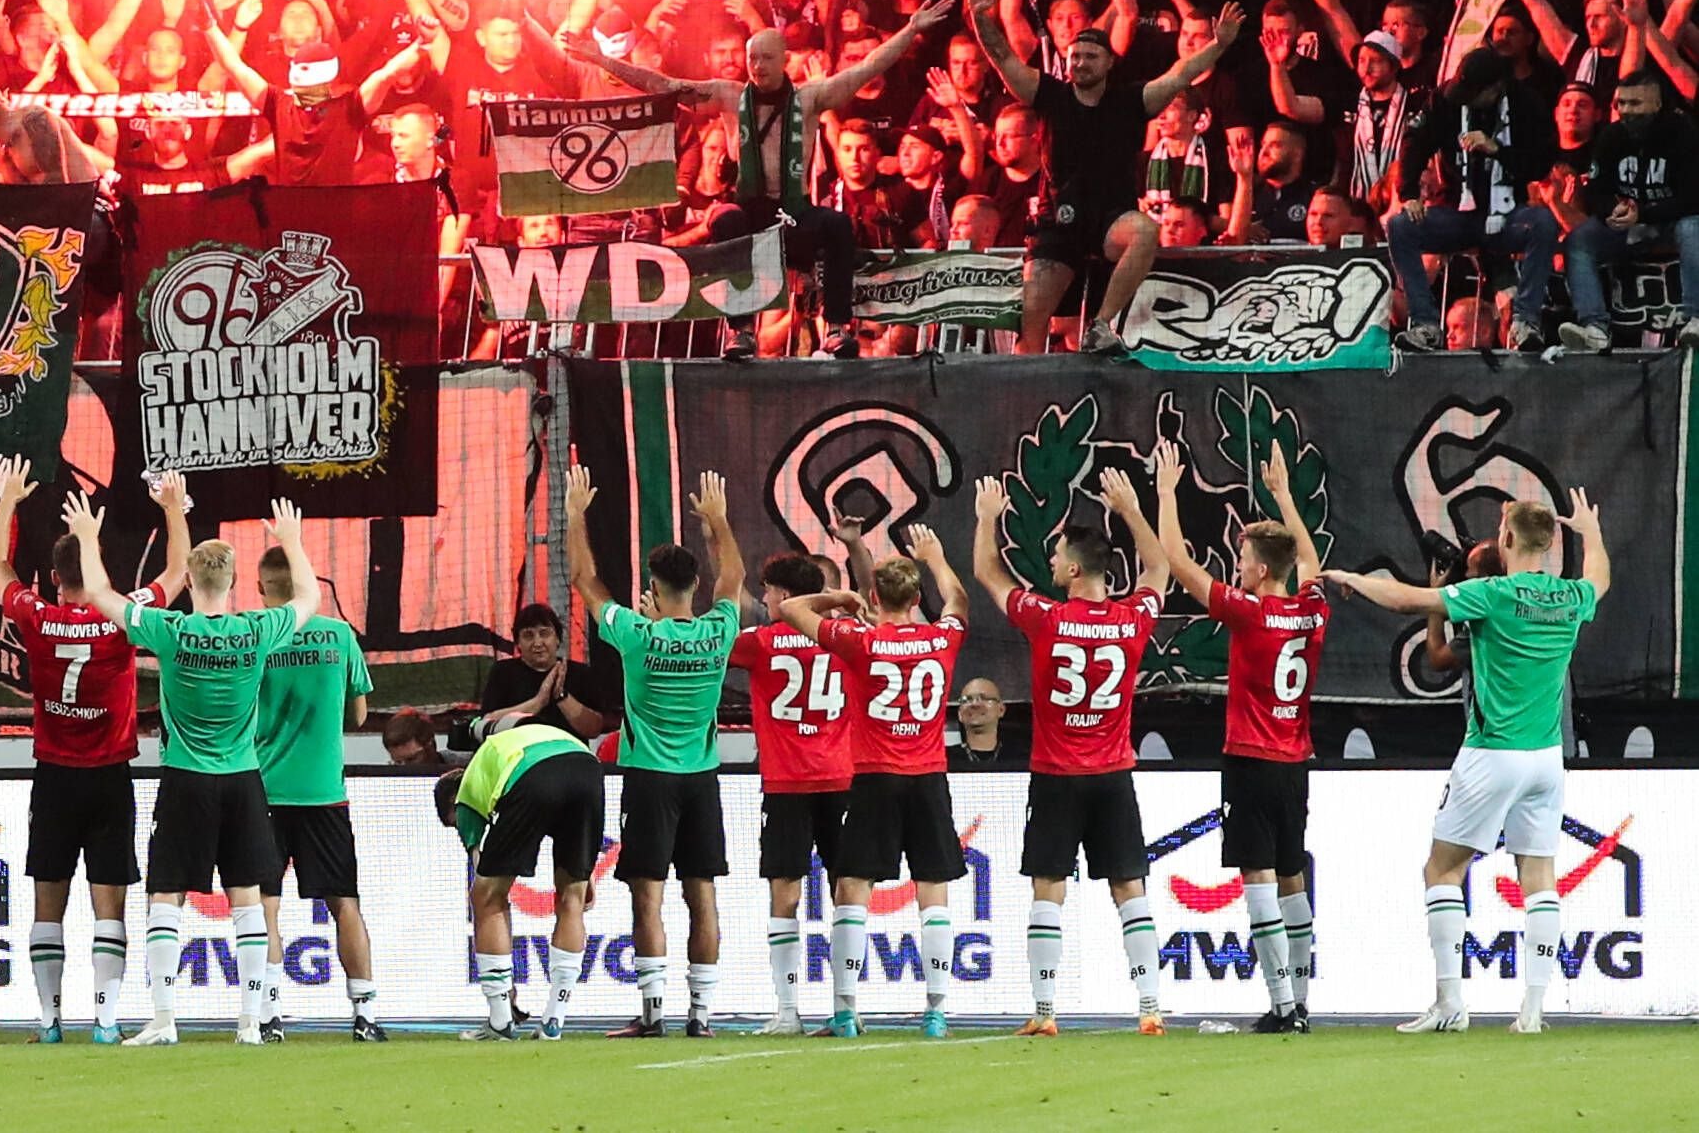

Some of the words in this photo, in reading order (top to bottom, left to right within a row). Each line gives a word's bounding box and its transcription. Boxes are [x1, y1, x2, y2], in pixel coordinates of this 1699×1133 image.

[506, 100, 655, 128] Hannover
[560, 126, 617, 190] 96
[470, 224, 785, 323] WDJ
[142, 339, 373, 408] STOCKHOLM
[145, 391, 373, 459] HANNOVER
[149, 450, 246, 472] Zusammen
[249, 447, 270, 462] im
[41, 620, 99, 639] HANNOVER
[100, 622, 117, 639] 96
[1058, 620, 1120, 641] HANNOVER
[1121, 622, 1136, 639] 96
[1265, 612, 1315, 631] HANNOVER
[179, 630, 261, 652] macron
[291, 629, 339, 647] cron
[649, 634, 722, 655] macron
[773, 633, 817, 650] HANNO
[871, 638, 933, 656] HANNOVER
[932, 635, 949, 653] 96
[174, 649, 239, 670] HANNOVER
[243, 650, 257, 667] 96
[266, 649, 320, 668] ANNOVER
[324, 649, 340, 665] 96
[643, 653, 709, 673] HANNOVER
[1272, 635, 1308, 703] 6
[54, 643, 92, 704] 7
[1049, 642, 1127, 711] 32
[769, 653, 846, 723] 24
[867, 658, 946, 724] 20
[891, 721, 921, 737] DEHM
[1537, 943, 1554, 956] 96
[845, 958, 861, 971] 96
[931, 958, 949, 971] 96
[1039, 968, 1056, 980] 96
[248, 979, 261, 991] 96
